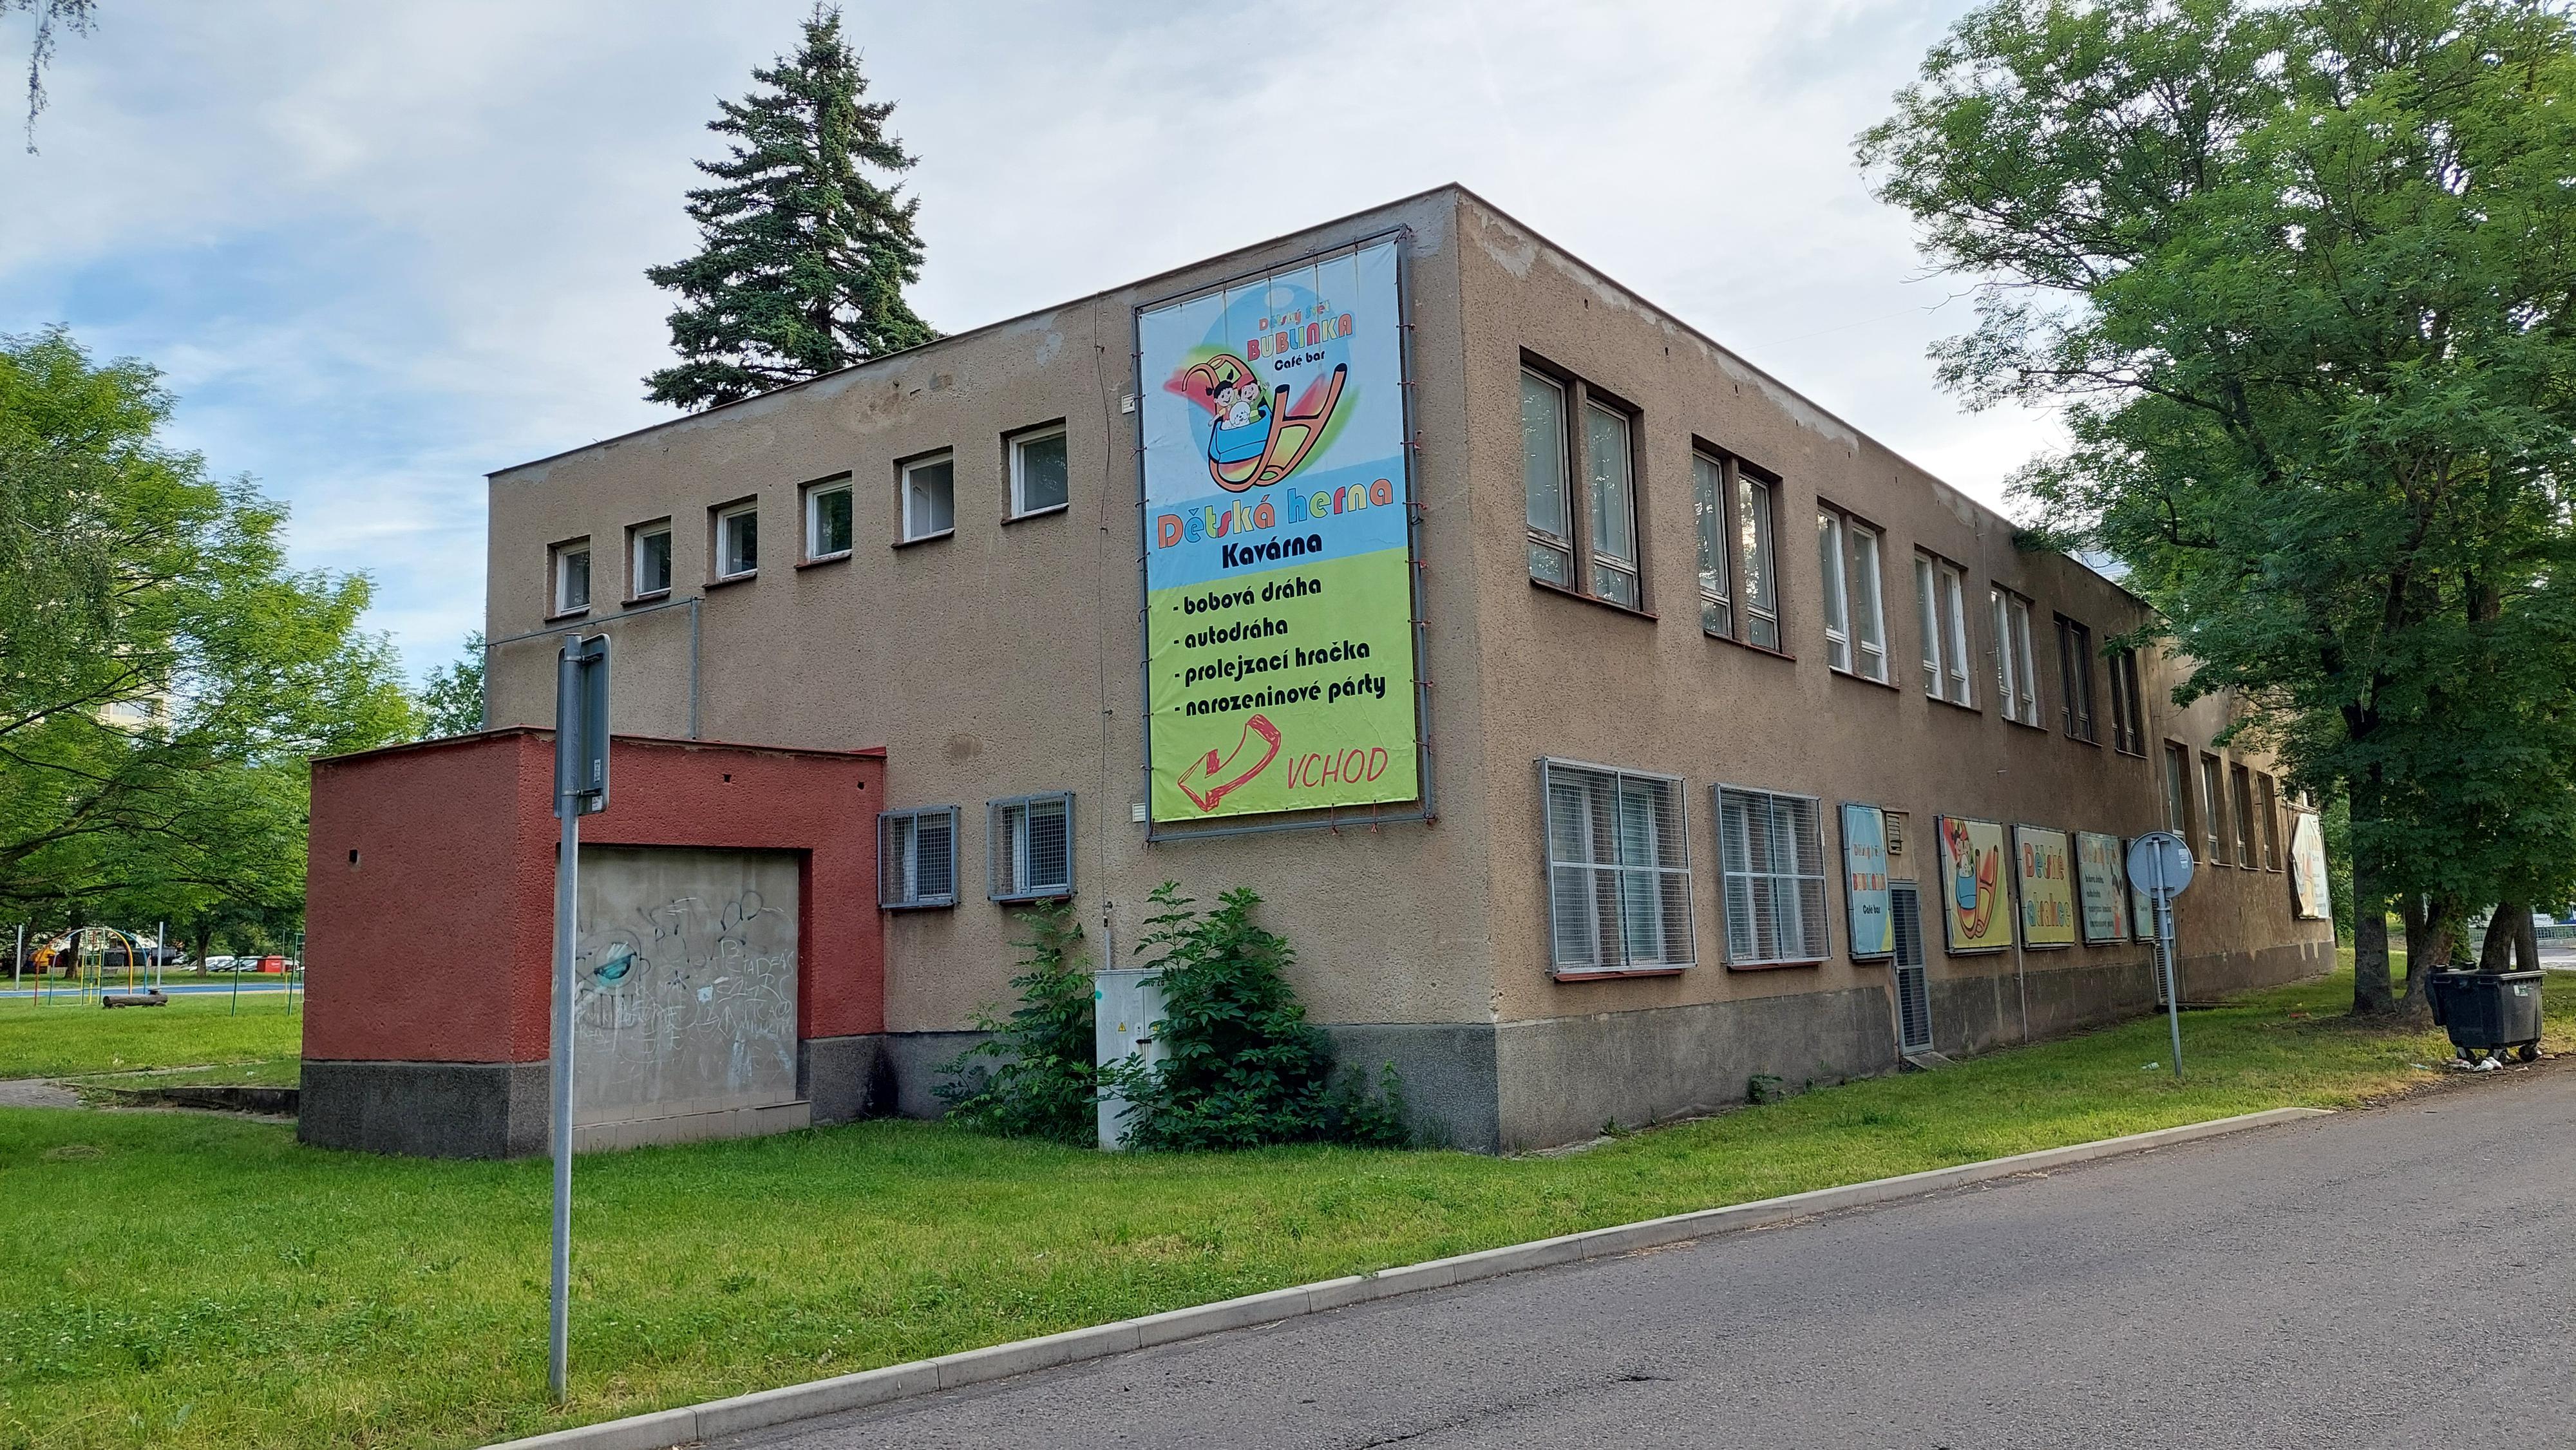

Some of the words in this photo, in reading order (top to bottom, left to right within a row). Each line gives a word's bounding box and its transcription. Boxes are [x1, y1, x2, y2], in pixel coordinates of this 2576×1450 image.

[1247, 313, 1352, 362] BUBLINKA
[1259, 309, 1302, 330] Dětský
[1274, 354, 1303, 371] Café
[1306, 351, 1325, 363] bar
[1158, 494, 1275, 549] Dětská
[1288, 478, 1394, 524] herna
[1222, 534, 1323, 569] Kavárna
[1184, 585, 1255, 615] bobová
[1262, 576, 1321, 602] dráha
[1185, 617, 1288, 649] autodráha
[1185, 650, 1289, 687] prolejzací
[1295, 639, 1370, 668] hračka
[1186, 681, 1321, 716] narozeninové
[1329, 674, 1385, 704] párty
[1289, 748, 1388, 788] VCHOD
[2024, 843, 2064, 880] Dětské
[1863, 905, 1873, 914] Café
